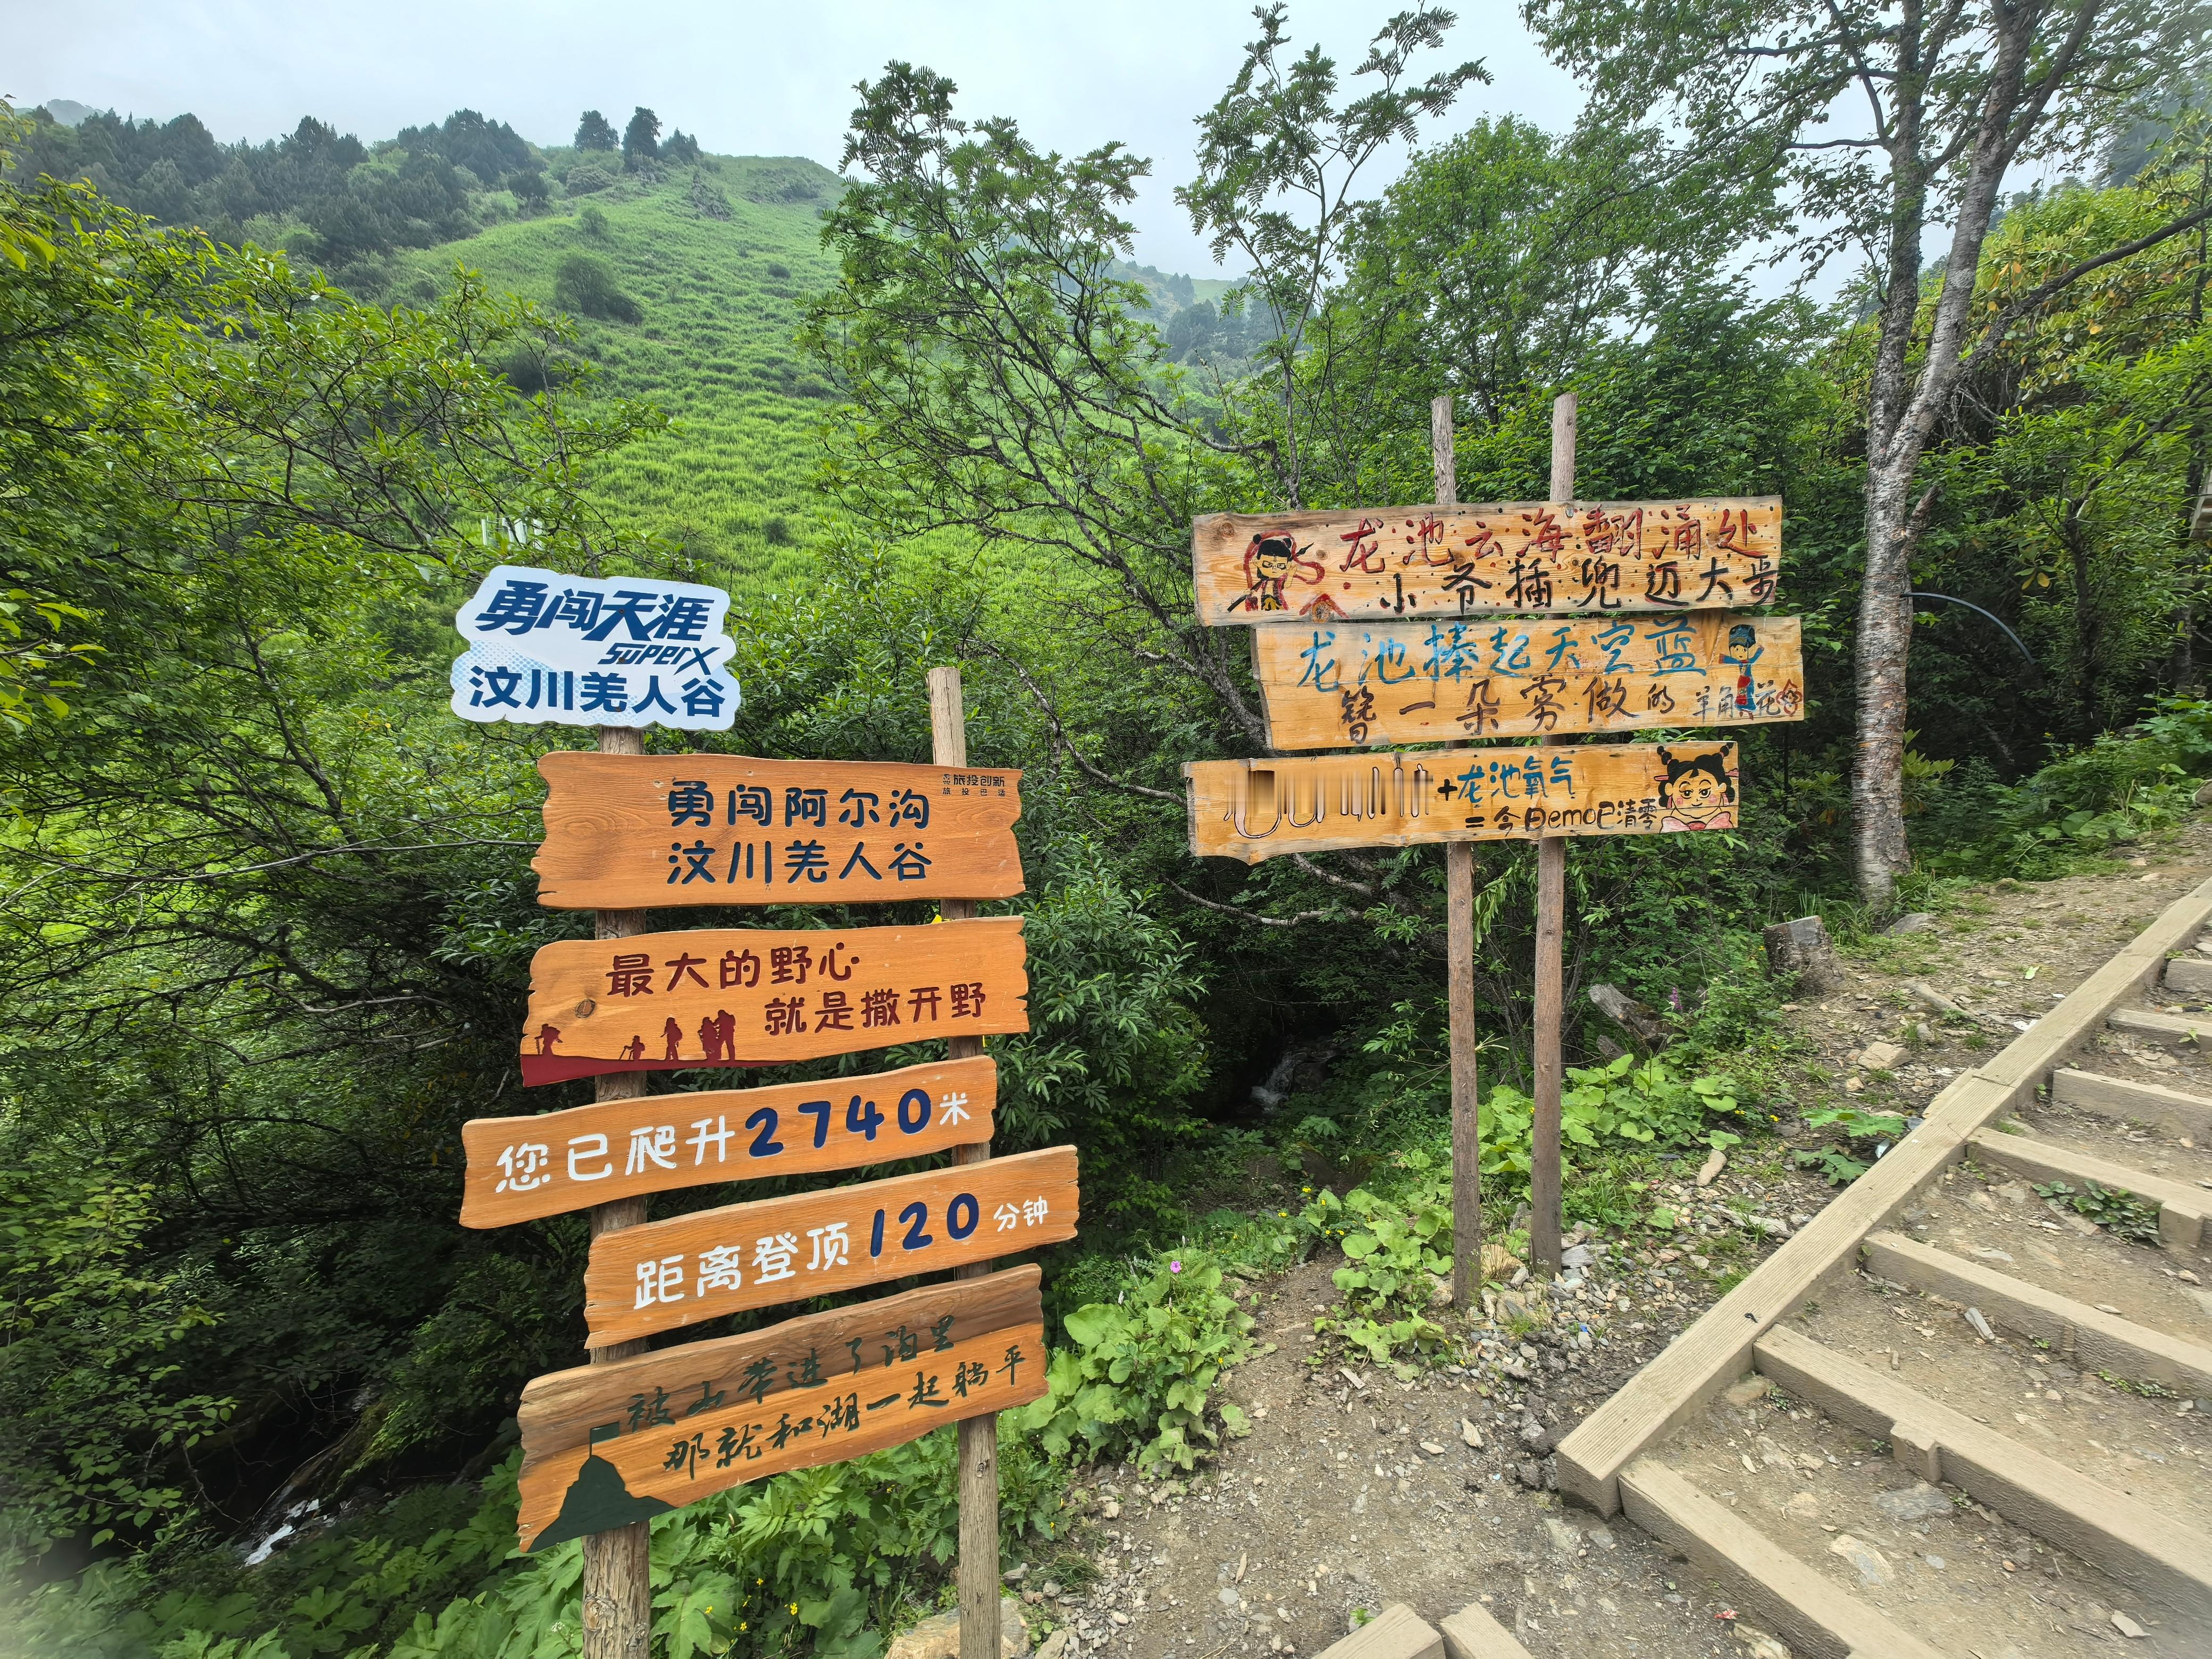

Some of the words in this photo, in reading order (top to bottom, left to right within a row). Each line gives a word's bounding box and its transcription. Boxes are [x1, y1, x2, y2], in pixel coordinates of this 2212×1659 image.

[1339, 503, 1769, 574] 龙池云海翻涌处
[475, 580, 715, 642] 勇闯天涯
[1379, 555, 1779, 615] 小爷插兜迈大步
[1297, 615, 1707, 692] 龙池捧起天空蓝
[470, 665, 725, 717] 汶川羌人谷
[667, 781, 929, 828] 勇闯阿尔沟
[943, 787, 1006, 797] 旅投巴适
[953, 774, 1005, 787] 旅投创新
[667, 839, 932, 884] 汶川羌人谷
[606, 942, 859, 998] 最大的野心
[764, 982, 986, 1036] 就是撒开野
[663, 1345, 1026, 1480] 那就和湖一起躺平
